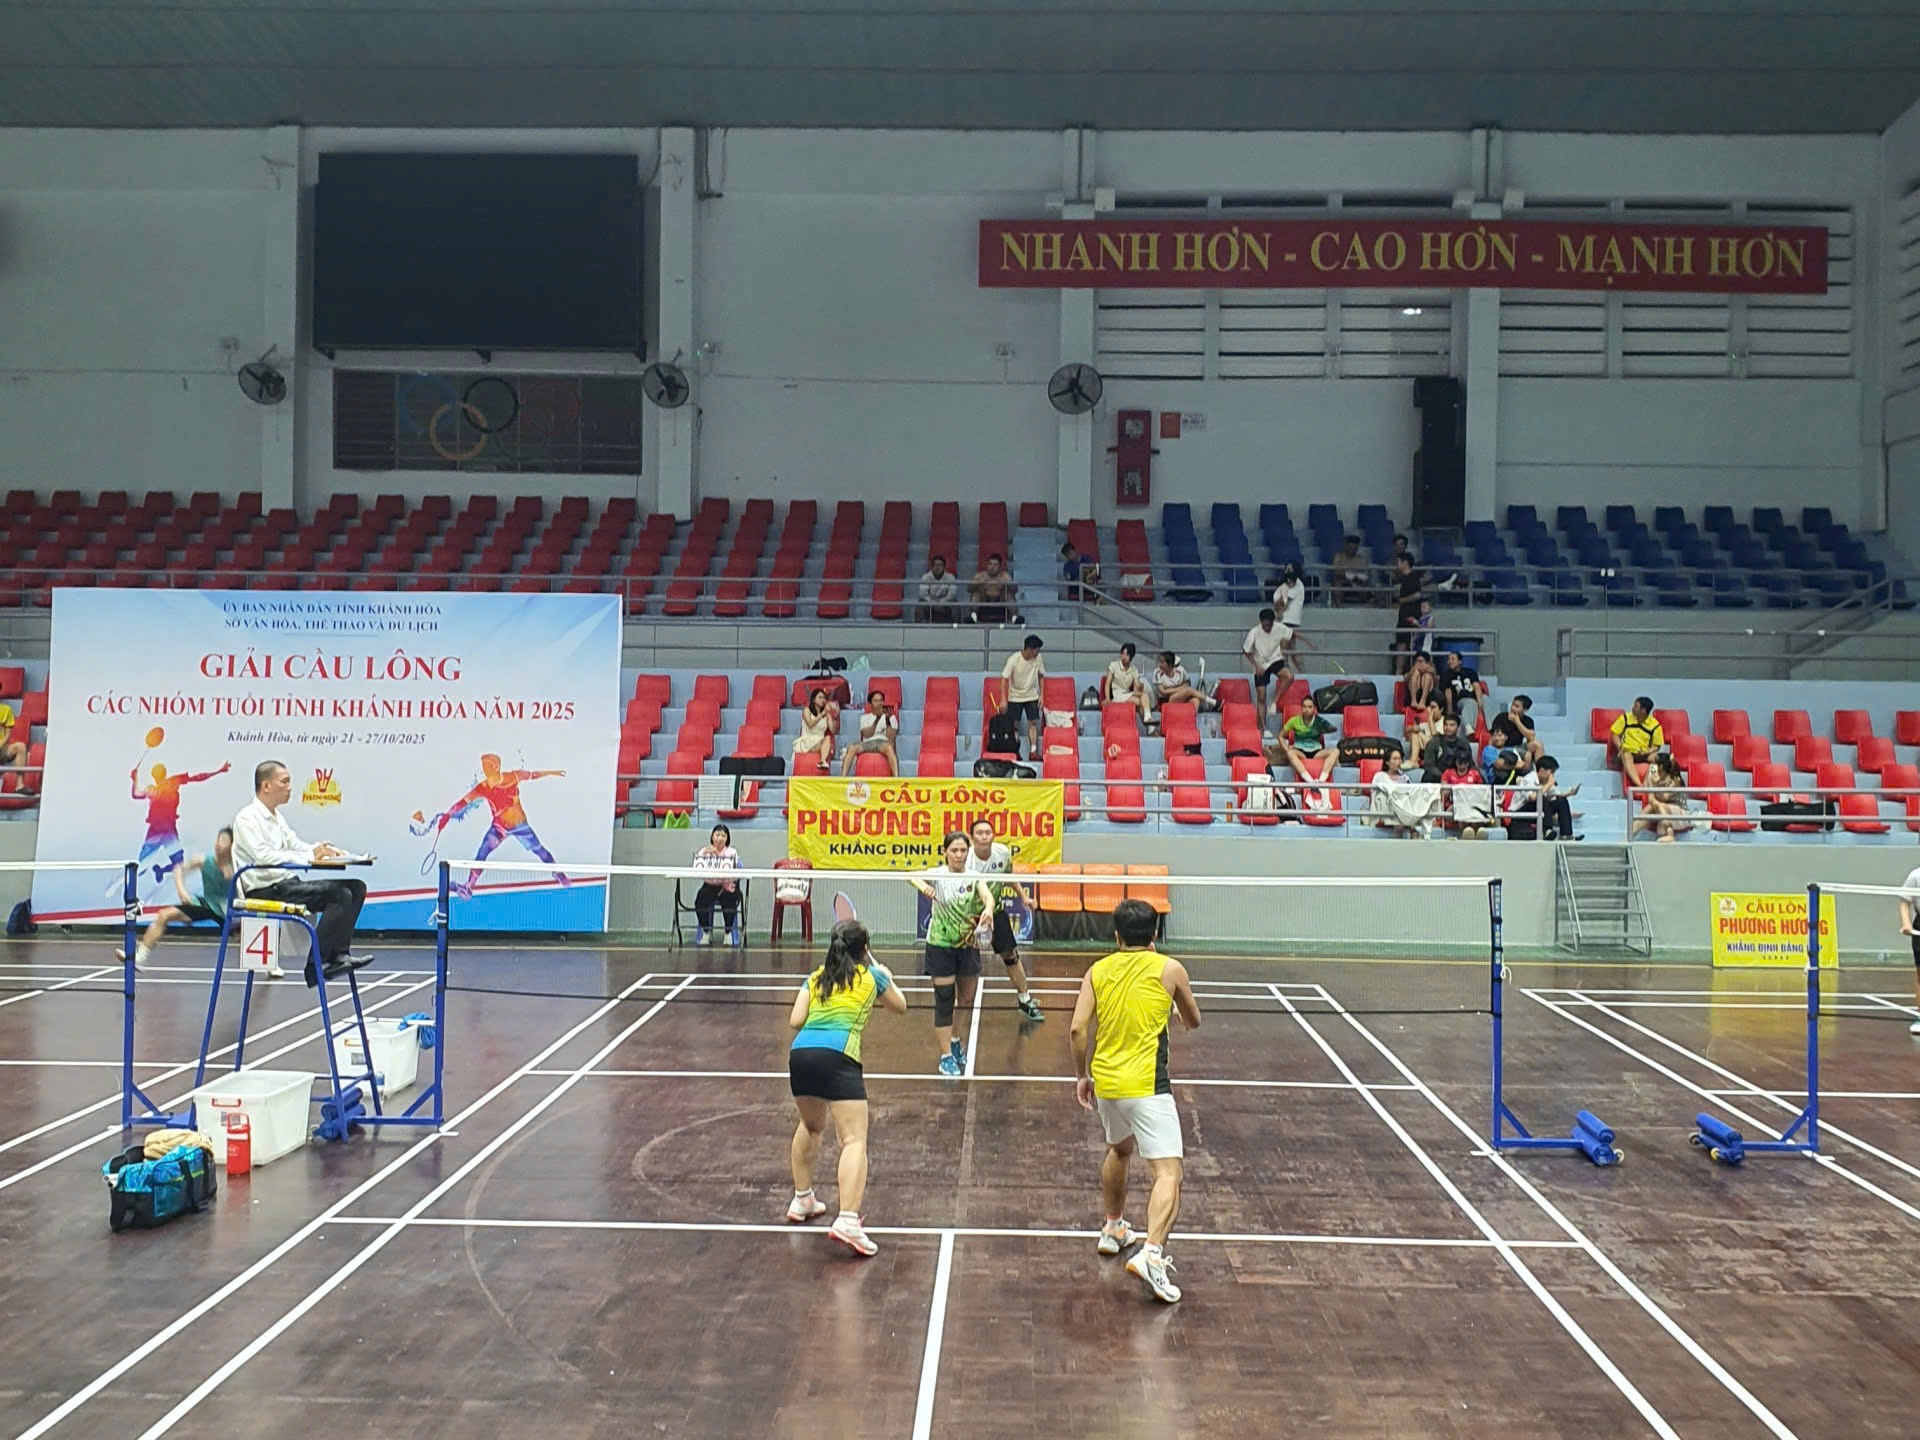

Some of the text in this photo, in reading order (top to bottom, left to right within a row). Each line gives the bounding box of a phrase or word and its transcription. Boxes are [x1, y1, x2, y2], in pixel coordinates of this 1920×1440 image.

[1000, 231, 1160, 270] NHANH
[1172, 226, 1271, 271] HƠN
[1310, 231, 1406, 271] CAO
[1419, 226, 1519, 271] HƠN
[1556, 233, 1697, 284] MẠNH
[1708, 232, 1806, 278] HƠN
[242, 602, 266, 613] BAN
[270, 600, 303, 613] NHÂN
[307, 601, 331, 614] DÂN
[368, 602, 412, 615] KHÁNH
[416, 602, 441, 615] HÒA
[332, 620, 365, 630] THAO
[368, 618, 385, 631] VÀ
[388, 620, 404, 631] DU
[408, 620, 438, 633] LỊCH
[200, 647, 463, 681] GIẢI CẦU LÔNG
[87, 690, 132, 715] CÁC
[138, 691, 205, 716] NHÓM
[271, 692, 324, 717] TỈNH
[332, 693, 412, 718] KHÁNH
[420, 694, 467, 719] HÒA
[473, 695, 524, 720] NĂM
[531, 701, 575, 721] 2025
[228, 731, 264, 743] Khánh
[268, 731, 293, 744] Hòa,
[296, 732, 310, 743] từ
[312, 732, 338, 747] ngày
[340, 733, 354, 744] 21
[365, 733, 426, 745] 27/10/2025
[880, 782, 932, 803] CẦU
[940, 784, 1006, 804] LÔNG
[797, 807, 1055, 838] PHƯƠNG HƯƠNG
[892, 843, 932, 858] ĐỊNH
[1746, 898, 1807, 914] CẦU LÔN
[1719, 917, 1829, 936] PHƯƠNG HƯƠG
[246, 925, 273, 965] 4
